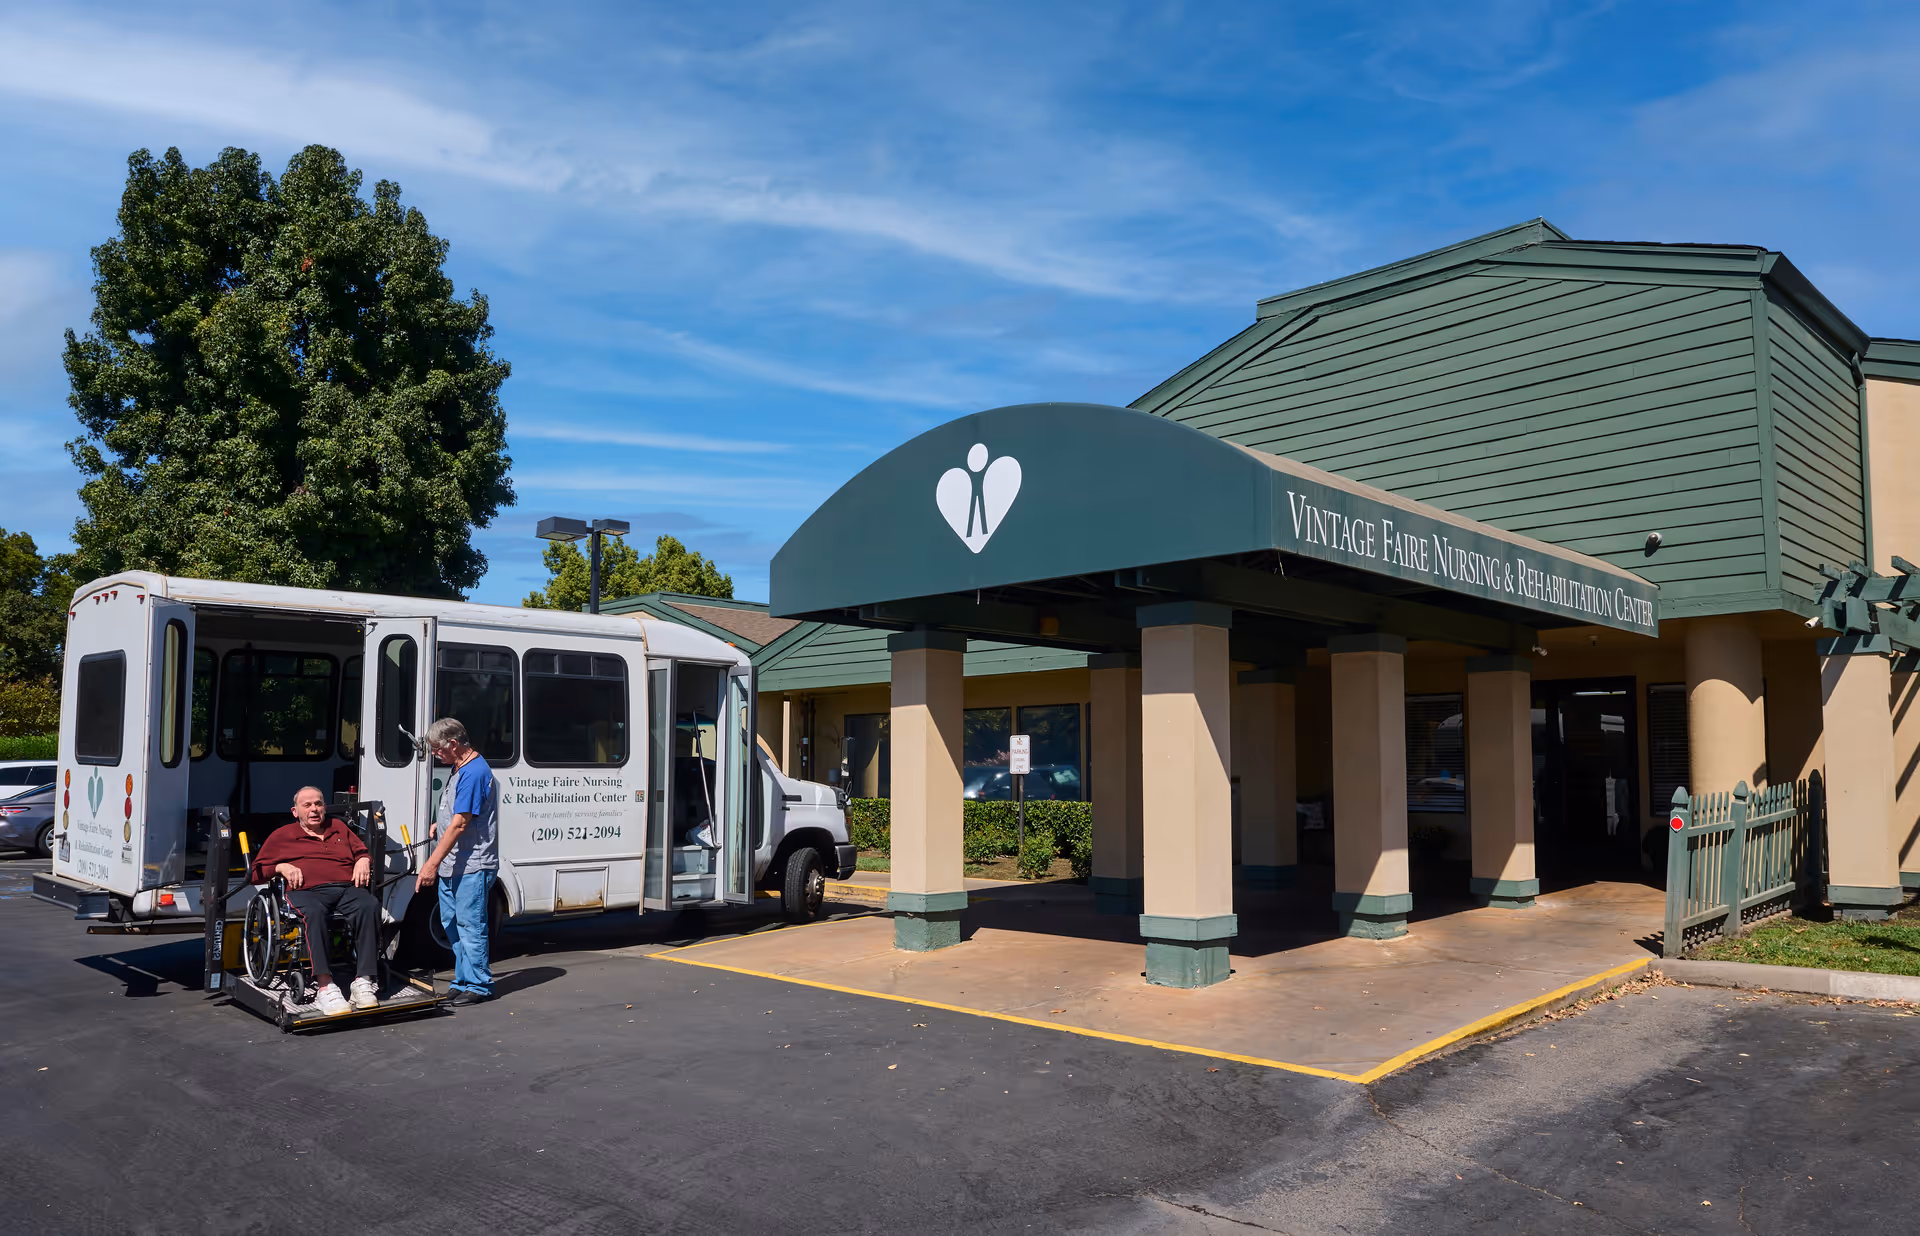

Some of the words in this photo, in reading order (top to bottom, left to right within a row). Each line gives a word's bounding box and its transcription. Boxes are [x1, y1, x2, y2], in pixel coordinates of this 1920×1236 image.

[1286, 491, 1376, 558] VINTAGE
[1381, 518, 1429, 573] FAIRE
[1433, 534, 1500, 590] NURSING
[1504, 561, 1514, 593] &
[1517, 558, 1612, 617] REHABILITATION
[1615, 587, 1655, 627] CENTER
[508, 776, 550, 789] Vintage
[553, 776, 580, 787] Faire
[583, 776, 622, 789] Nursing
[502, 793, 512, 804] &
[516, 793, 591, 804] Rehabilitation
[593, 792, 627, 803] Center
[552, 811, 572, 820] family
[531, 827, 564, 844] (209)
[567, 825, 621, 841] 521-2094
